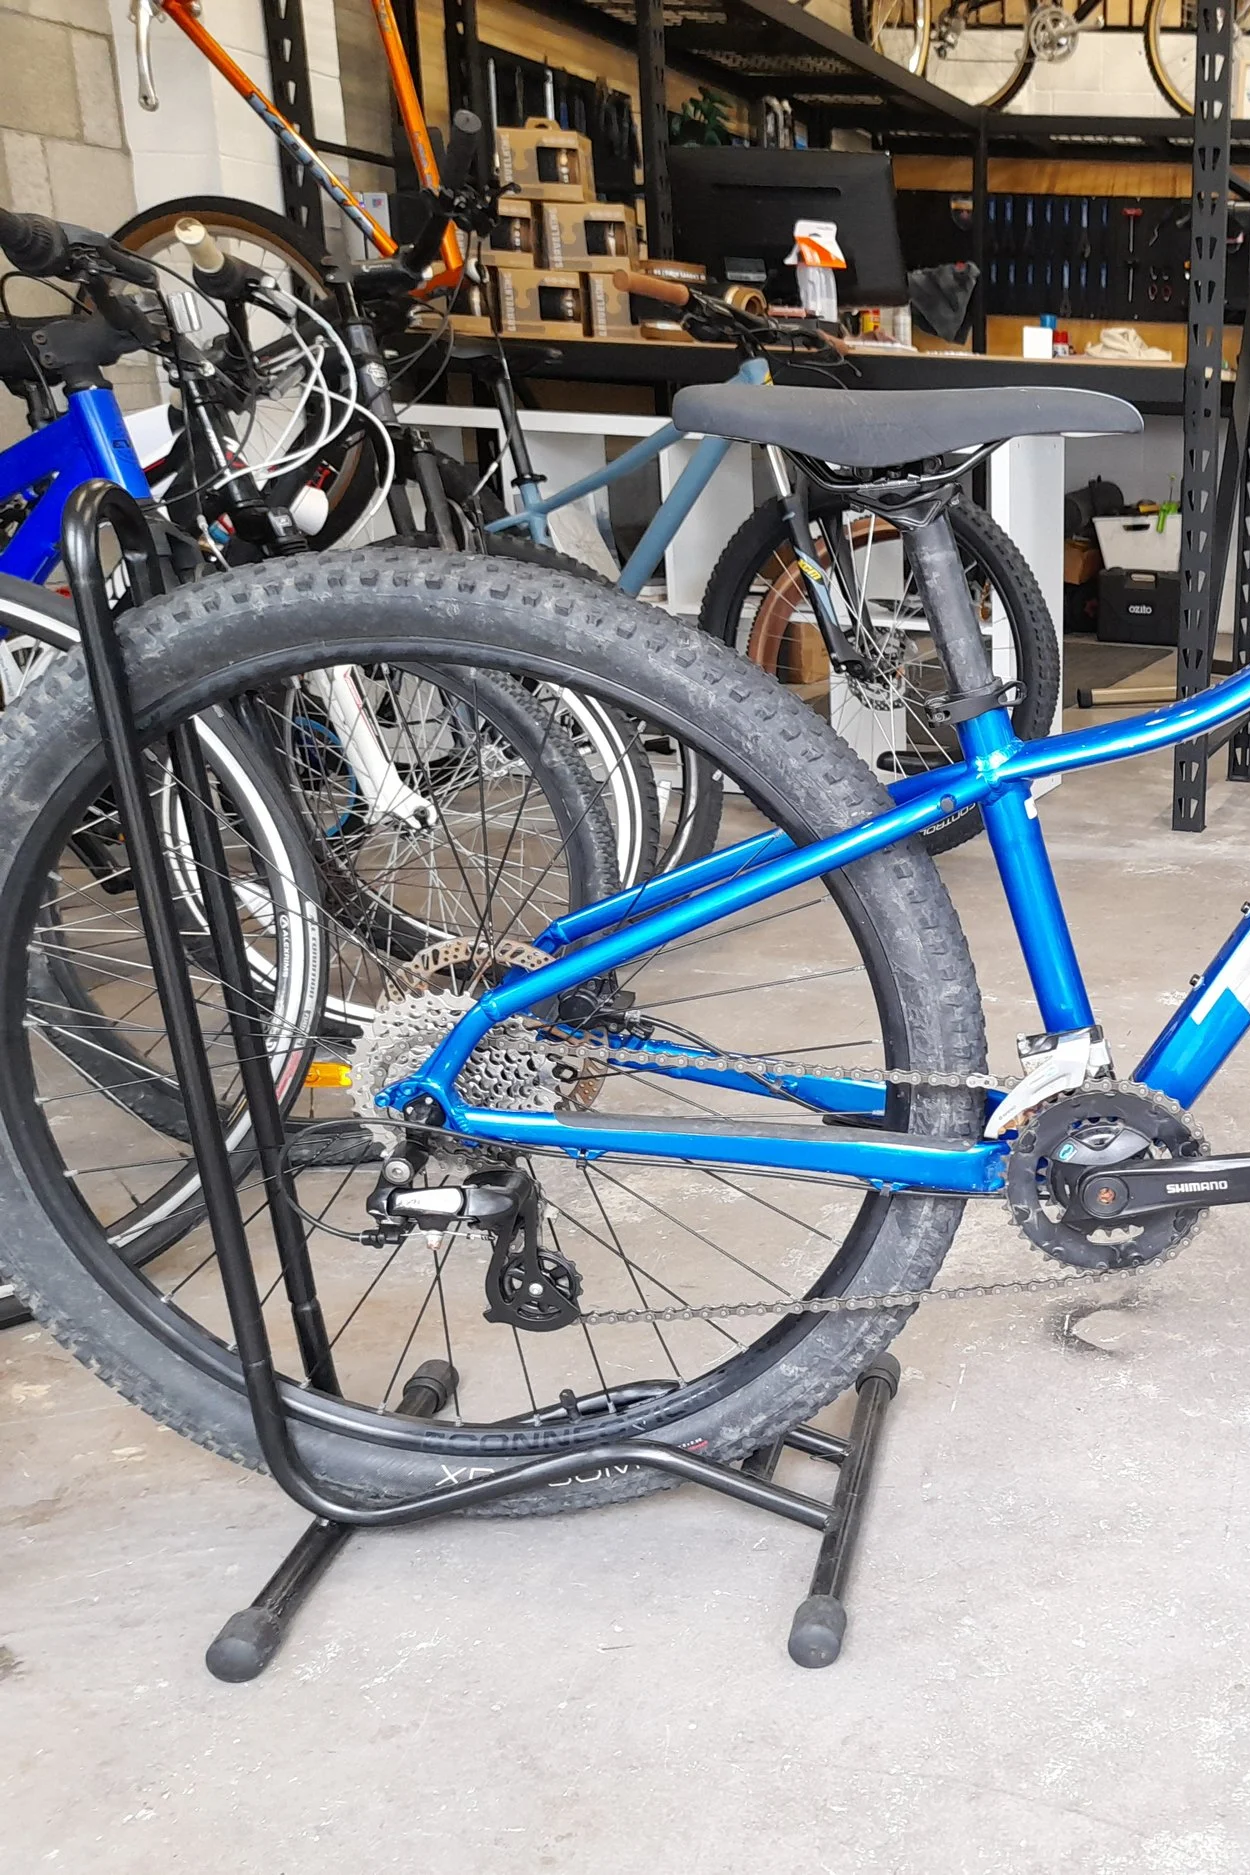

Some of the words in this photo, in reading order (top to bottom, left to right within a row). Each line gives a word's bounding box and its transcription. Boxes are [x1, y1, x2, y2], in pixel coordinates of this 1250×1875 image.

[1128, 604, 1153, 615] ozito
[281, 929, 292, 978] ALEXRIMS
[1166, 1180, 1229, 1194] SHIMANO
